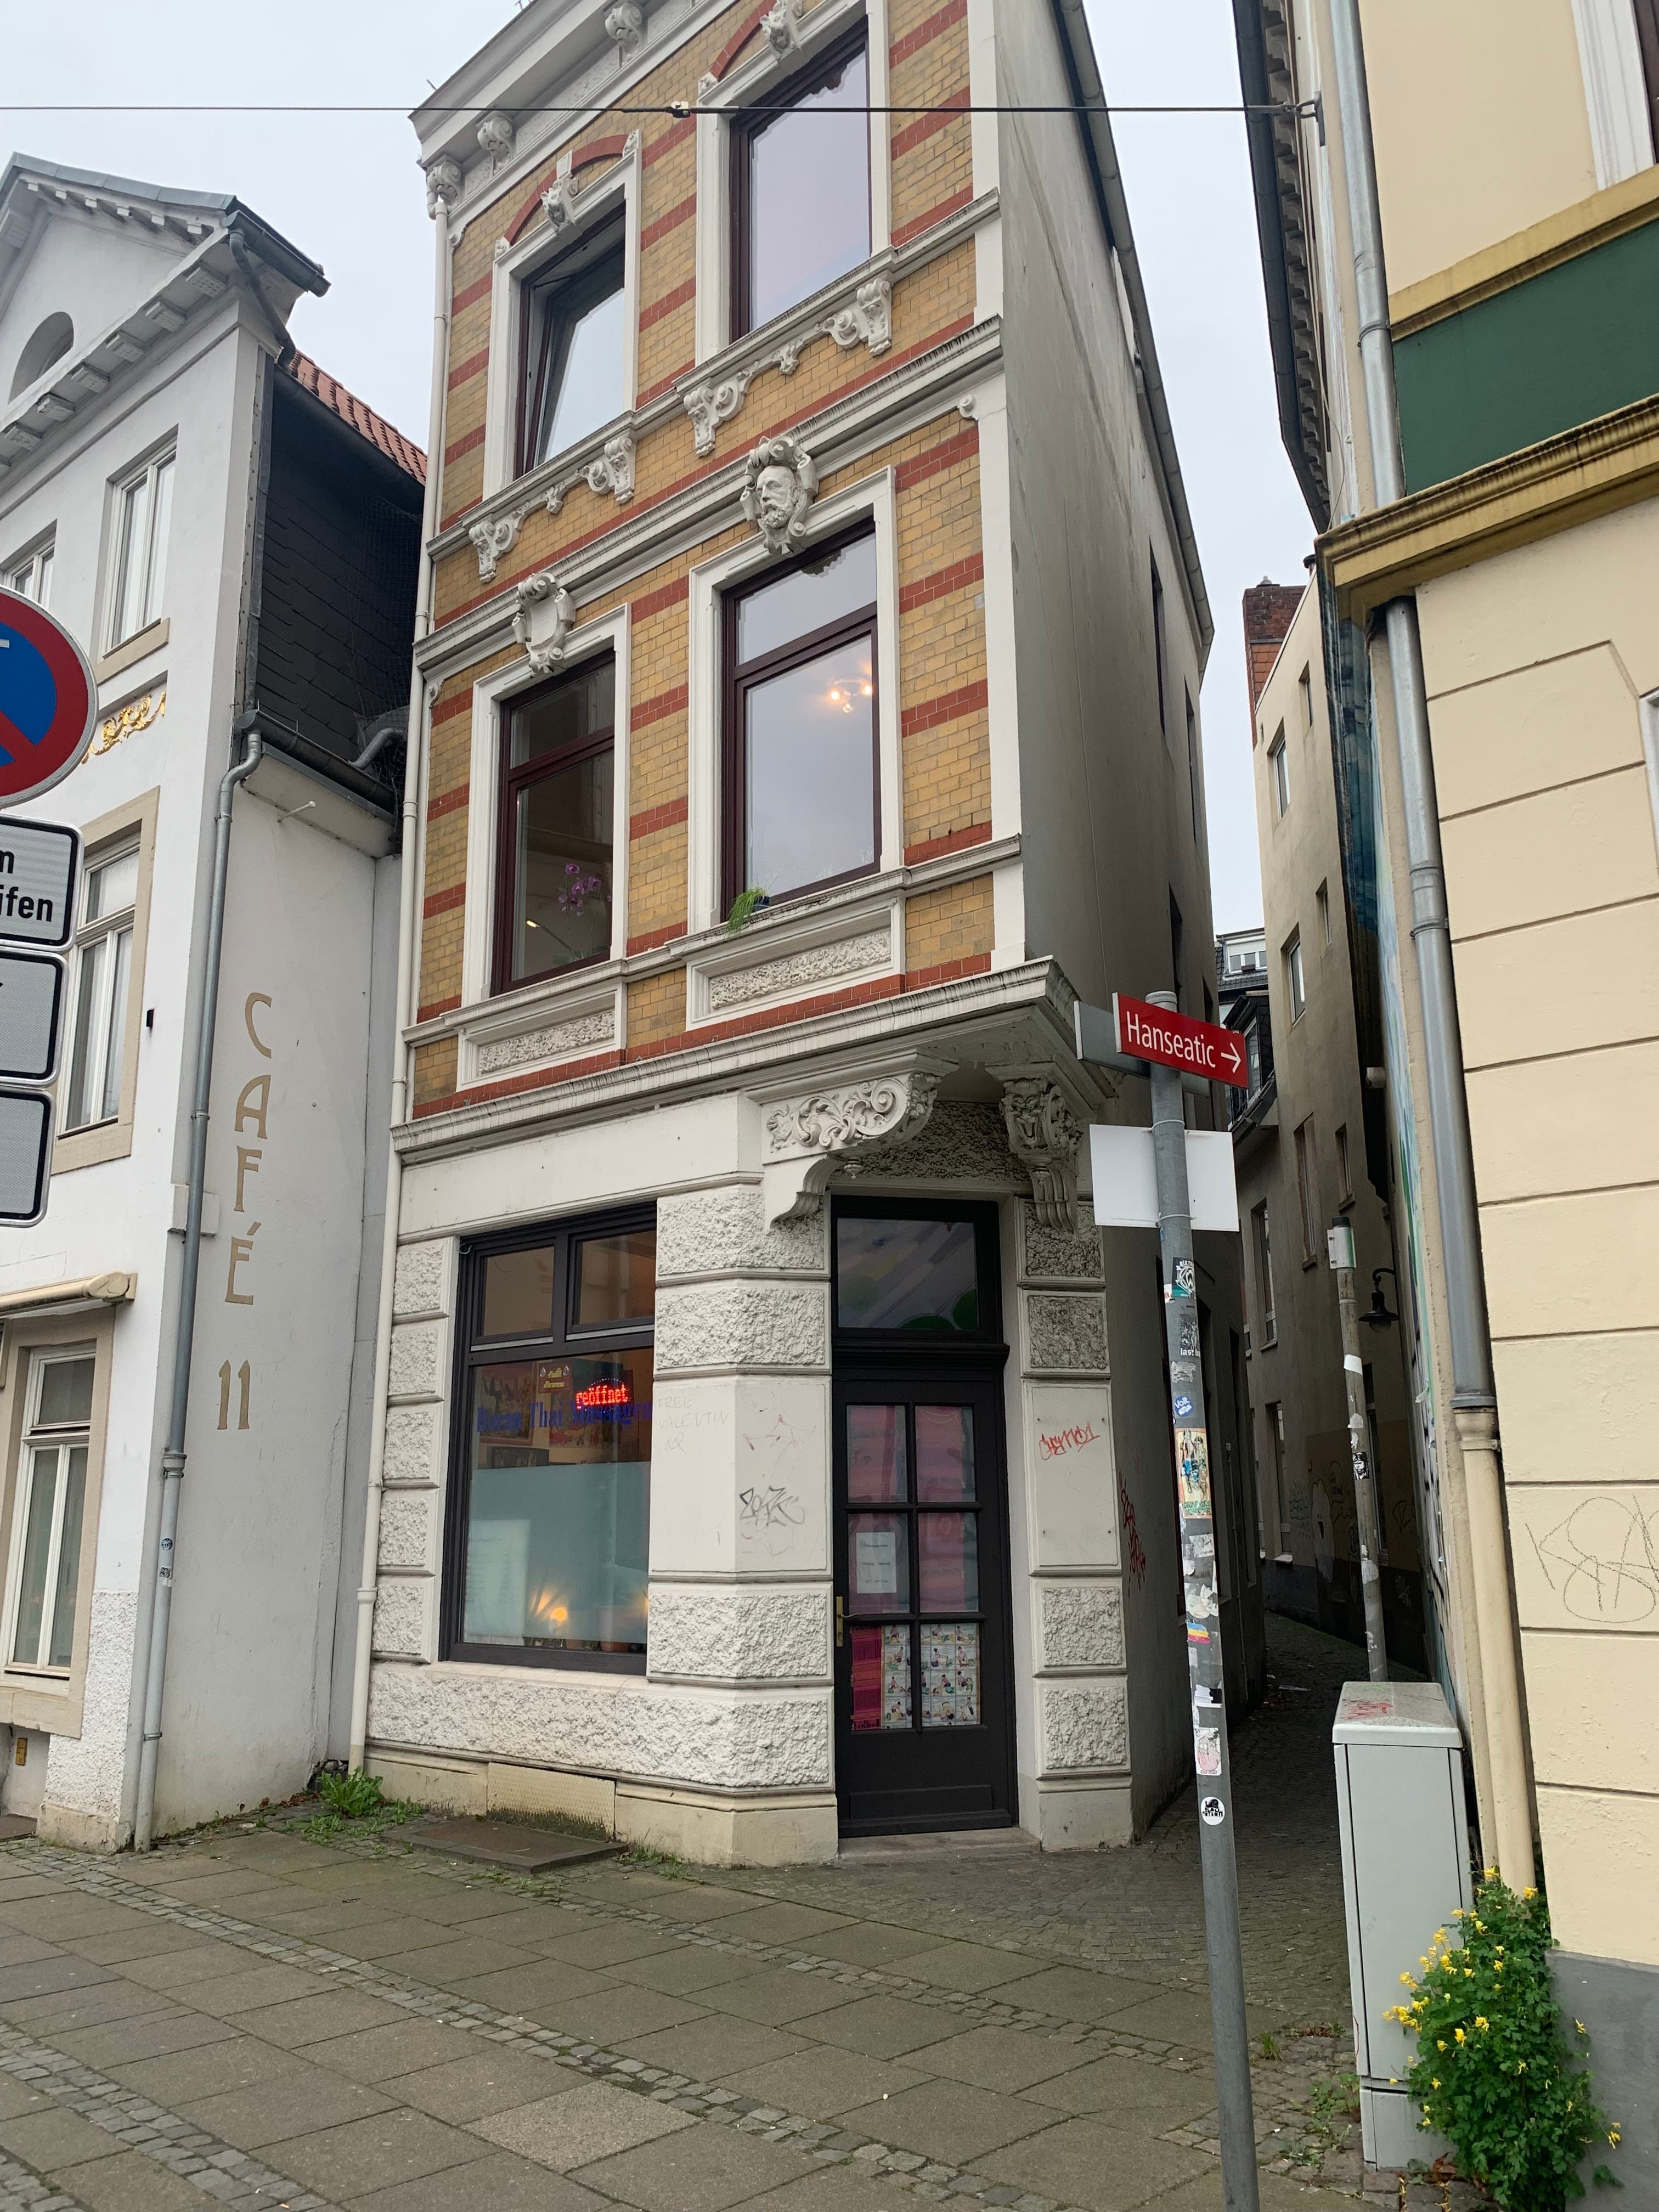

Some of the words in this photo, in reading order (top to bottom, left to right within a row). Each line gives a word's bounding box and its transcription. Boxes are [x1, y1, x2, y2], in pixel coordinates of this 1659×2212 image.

[1126, 1011, 1216, 1068] Hanseatic
[224, 992, 272, 1305] CAFÉ
[529, 1401, 562, 1427] Thai
[1174, 1397, 1190, 1409] Volt
